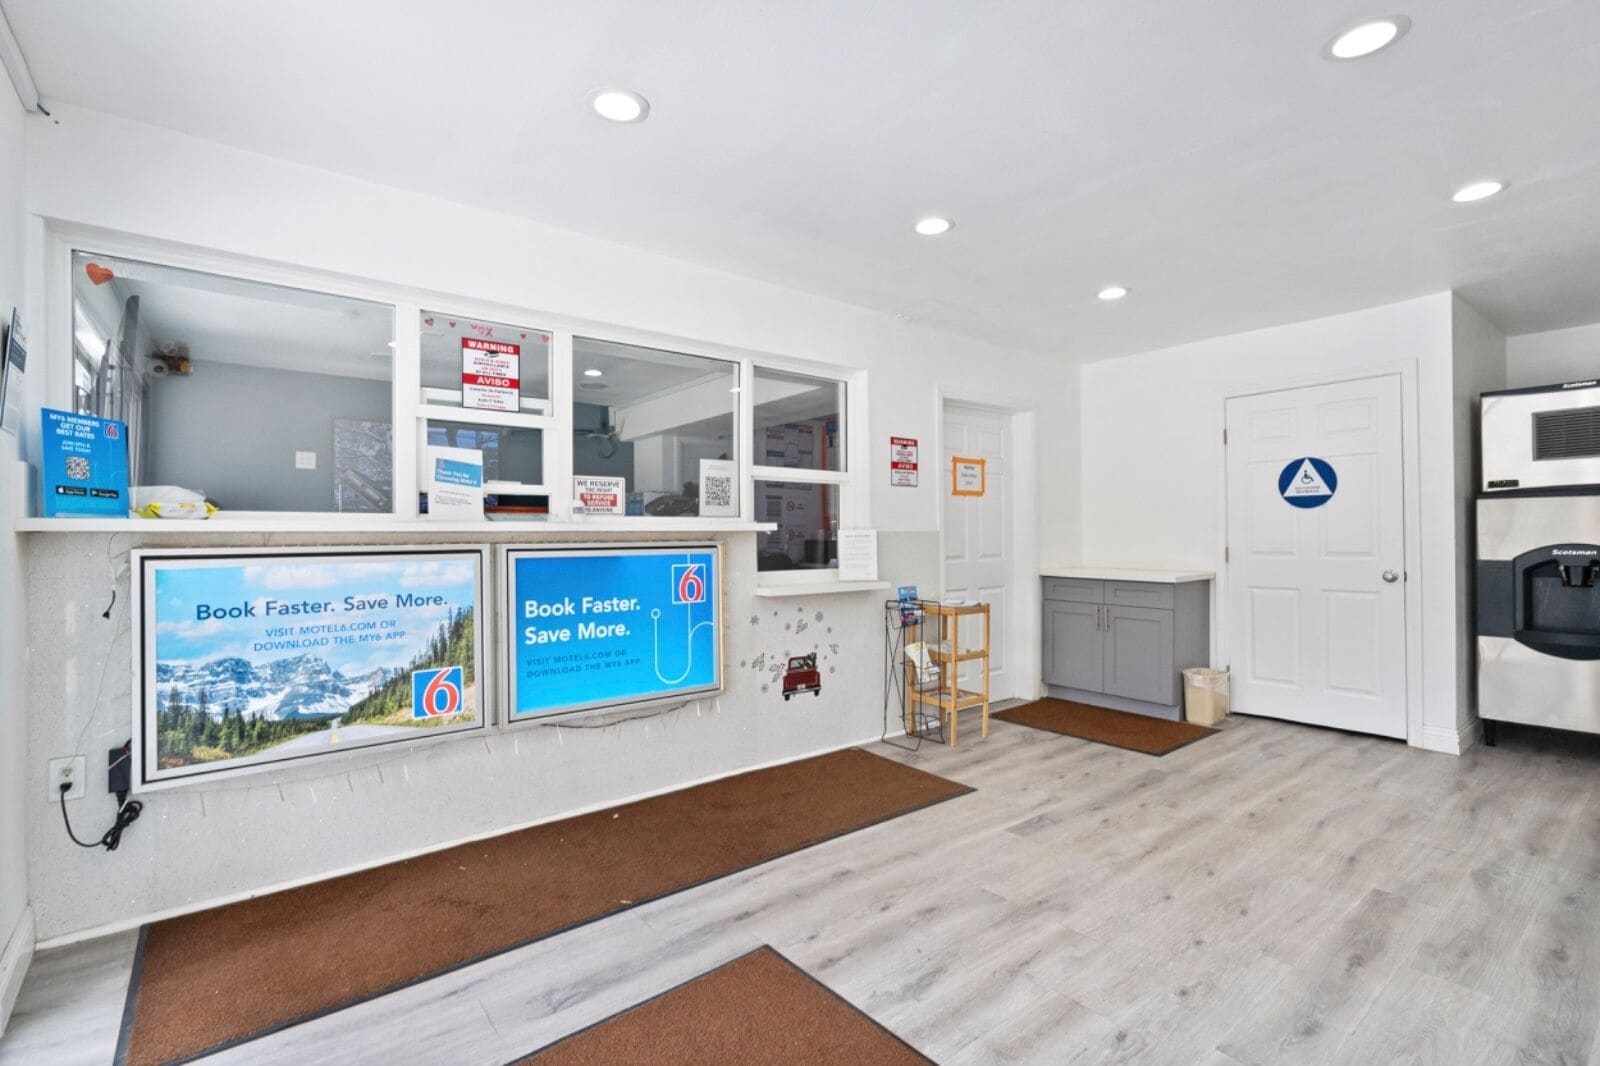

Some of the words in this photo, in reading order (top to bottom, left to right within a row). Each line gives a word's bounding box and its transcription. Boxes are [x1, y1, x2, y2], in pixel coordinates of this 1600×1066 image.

[468, 340, 514, 353] WARNING
[477, 376, 510, 386] AVISO
[60, 422, 74, 430] GET
[76, 424, 90, 432] OUR
[67, 416, 100, 427] MEMBERS
[56, 428, 72, 436] BEST
[74, 430, 95, 440] RATES
[678, 564, 704, 604] 6
[196, 602, 256, 620] Book
[266, 600, 334, 616] Faster.
[344, 596, 388, 612] Save
[396, 594, 448, 608] More.
[524, 597, 575, 618] Book
[582, 596, 640, 614] Faster.
[266, 627, 294, 638] VISIT
[300, 622, 376, 635] MOTEL6.COM
[380, 620, 396, 629] OR
[524, 626, 570, 645] Save
[578, 622, 630, 640] More.
[254, 638, 330, 652] DOWNLOAD
[334, 636, 354, 645] THE
[358, 633, 382, 642] MY6
[385, 630, 406, 640] APP
[526, 657, 550, 667] VISIT
[554, 650, 612, 665] MOTEL6.COM
[615, 648, 628, 656] OR
[526, 664, 582, 678] DOWNLOAD
[584, 662, 601, 671] THE
[625, 658, 640, 666] APP
[422, 667, 460, 717] 6
